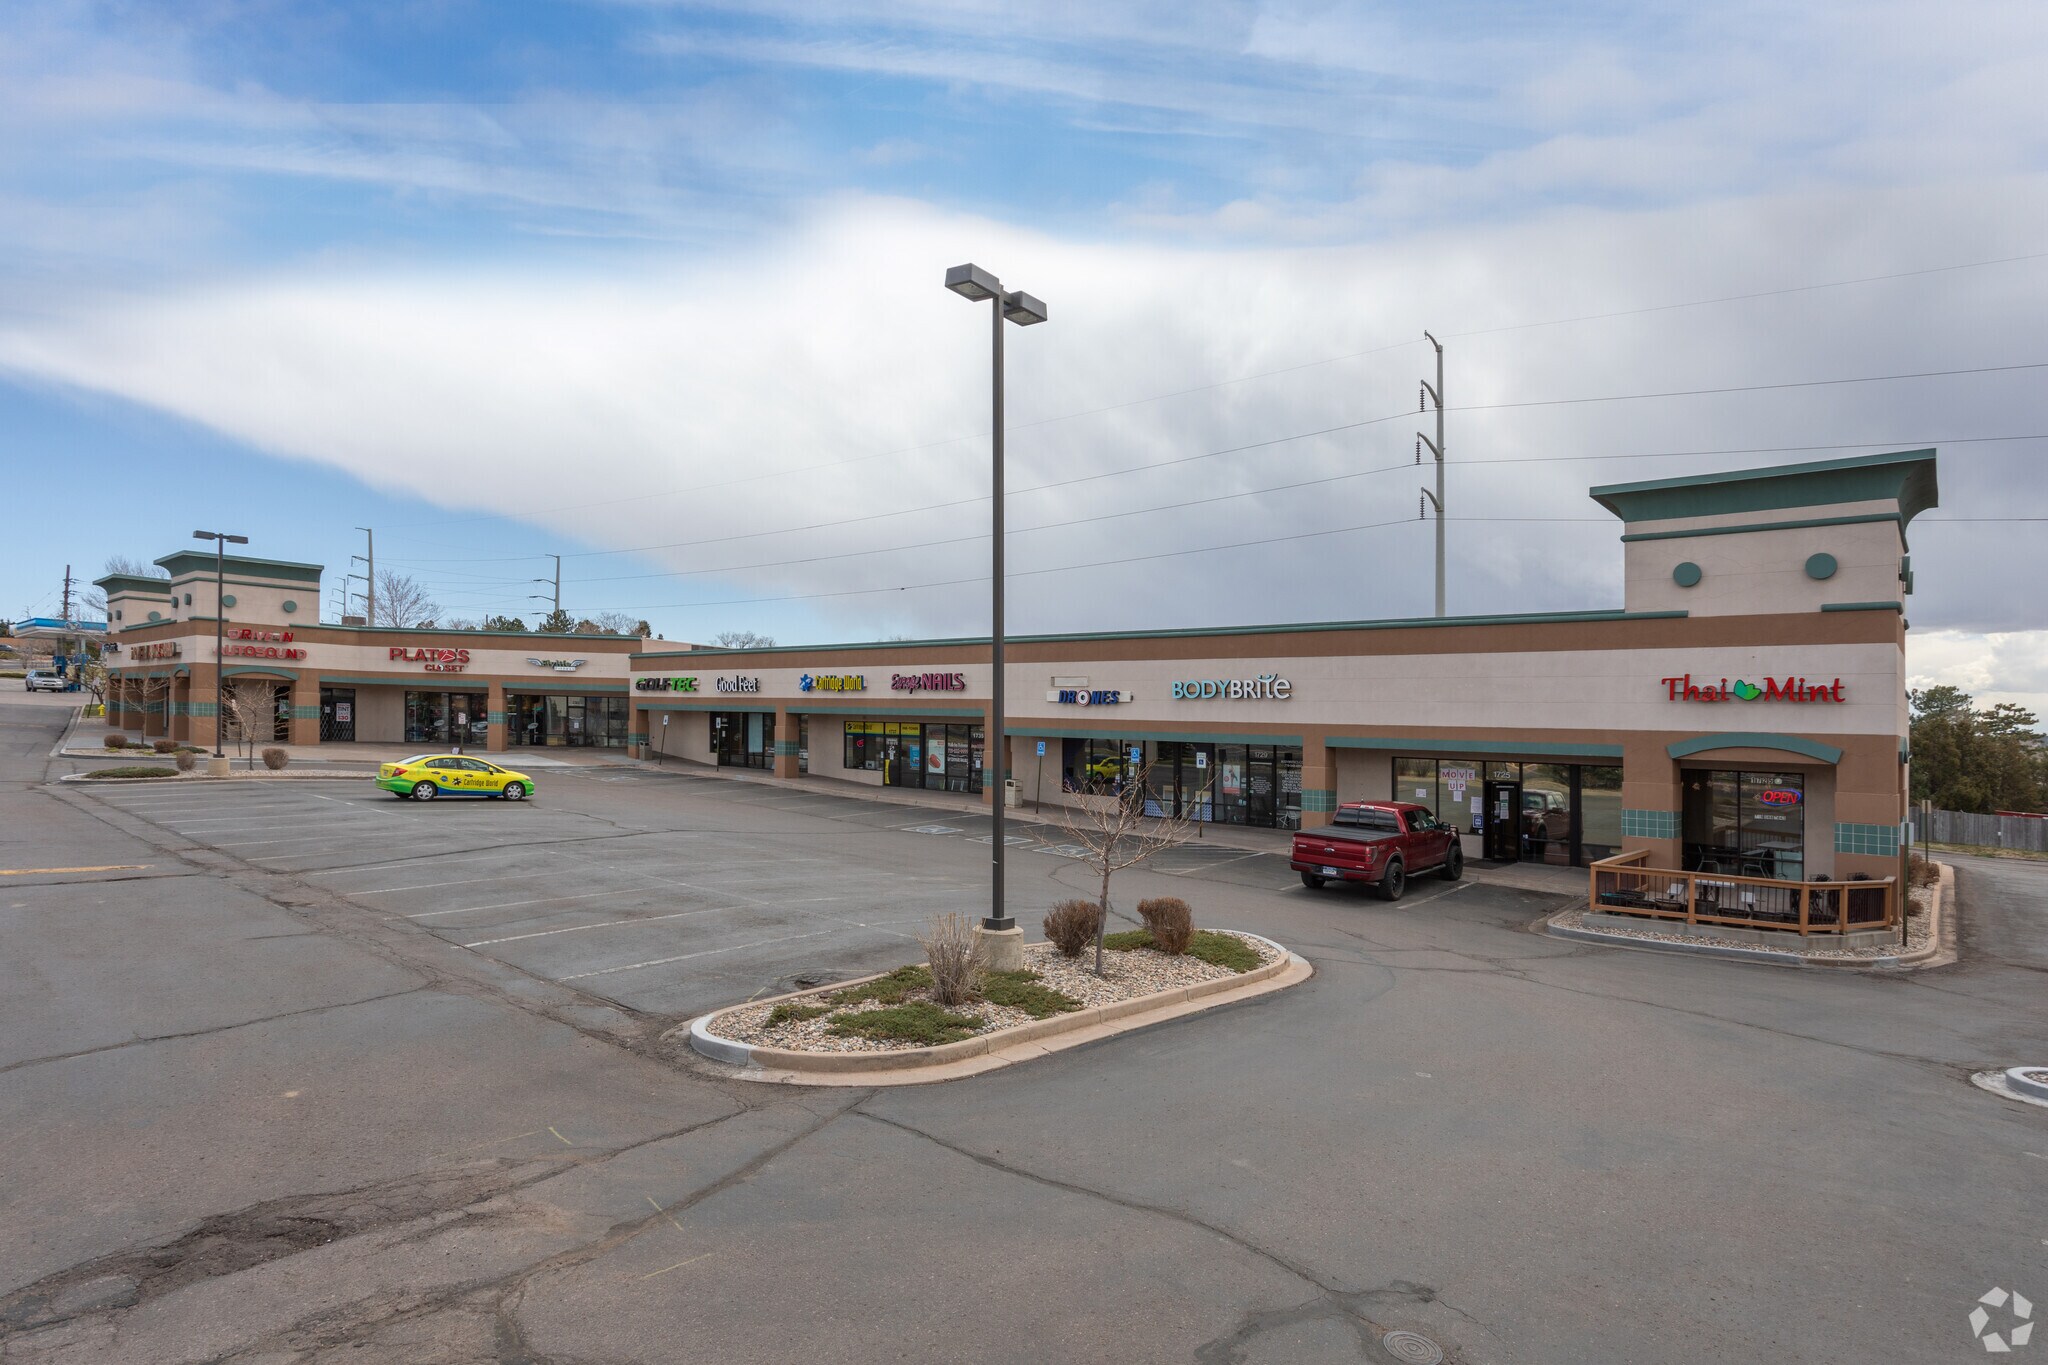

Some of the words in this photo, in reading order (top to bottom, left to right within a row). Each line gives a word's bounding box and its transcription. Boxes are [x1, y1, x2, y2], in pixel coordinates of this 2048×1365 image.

[212, 645, 307, 660] AUTOSOUND
[389, 647, 470, 663] PLATO'S
[424, 663, 464, 672] CLOSET
[716, 675, 739, 692] Good
[739, 676, 759, 692] Feet
[815, 675, 843, 693] Cartridge
[843, 675, 865, 691] World
[921, 673, 966, 691] NAILS
[1661, 674, 1731, 701] Thai
[1763, 676, 1846, 702] Mint
[1058, 689, 1121, 706] DRONES
[1763, 790, 1798, 804] OPEN
